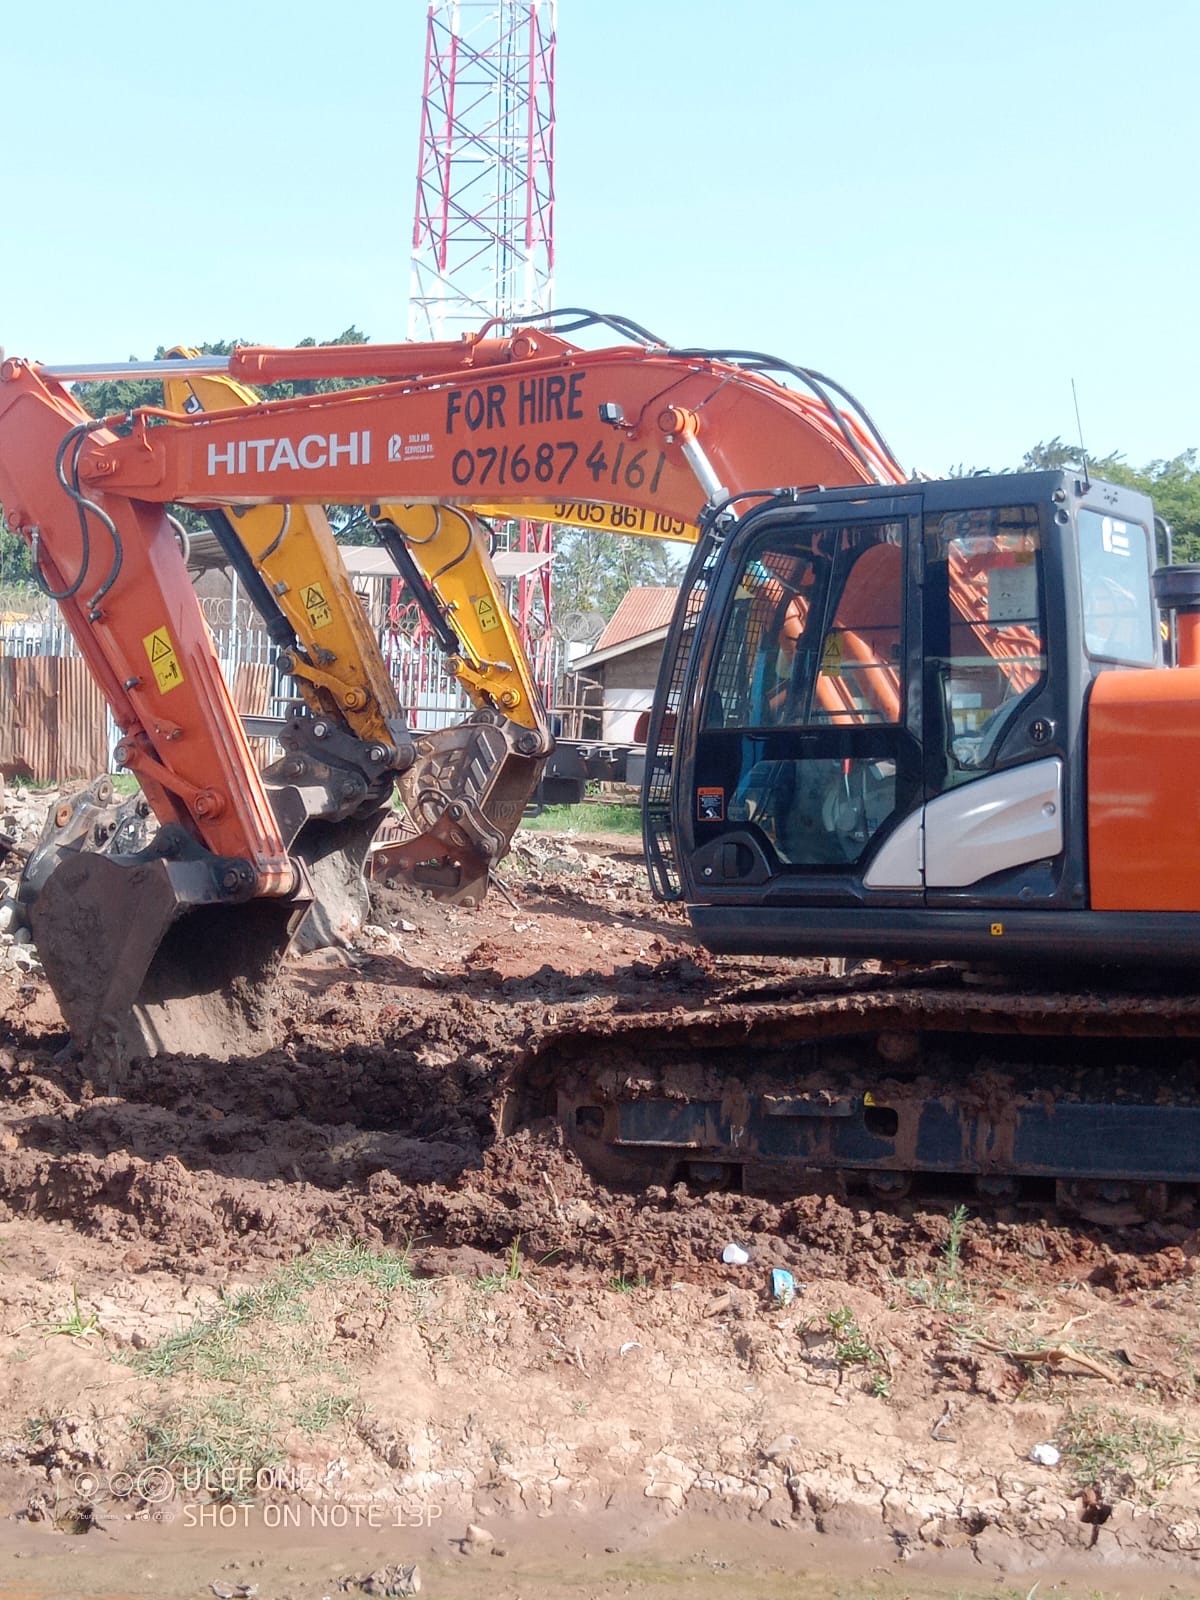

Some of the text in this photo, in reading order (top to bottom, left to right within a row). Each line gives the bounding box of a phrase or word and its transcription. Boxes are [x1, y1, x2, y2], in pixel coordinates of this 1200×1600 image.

[446, 372, 586, 434] FOR HIRE
[207, 430, 370, 476] HITACHI
